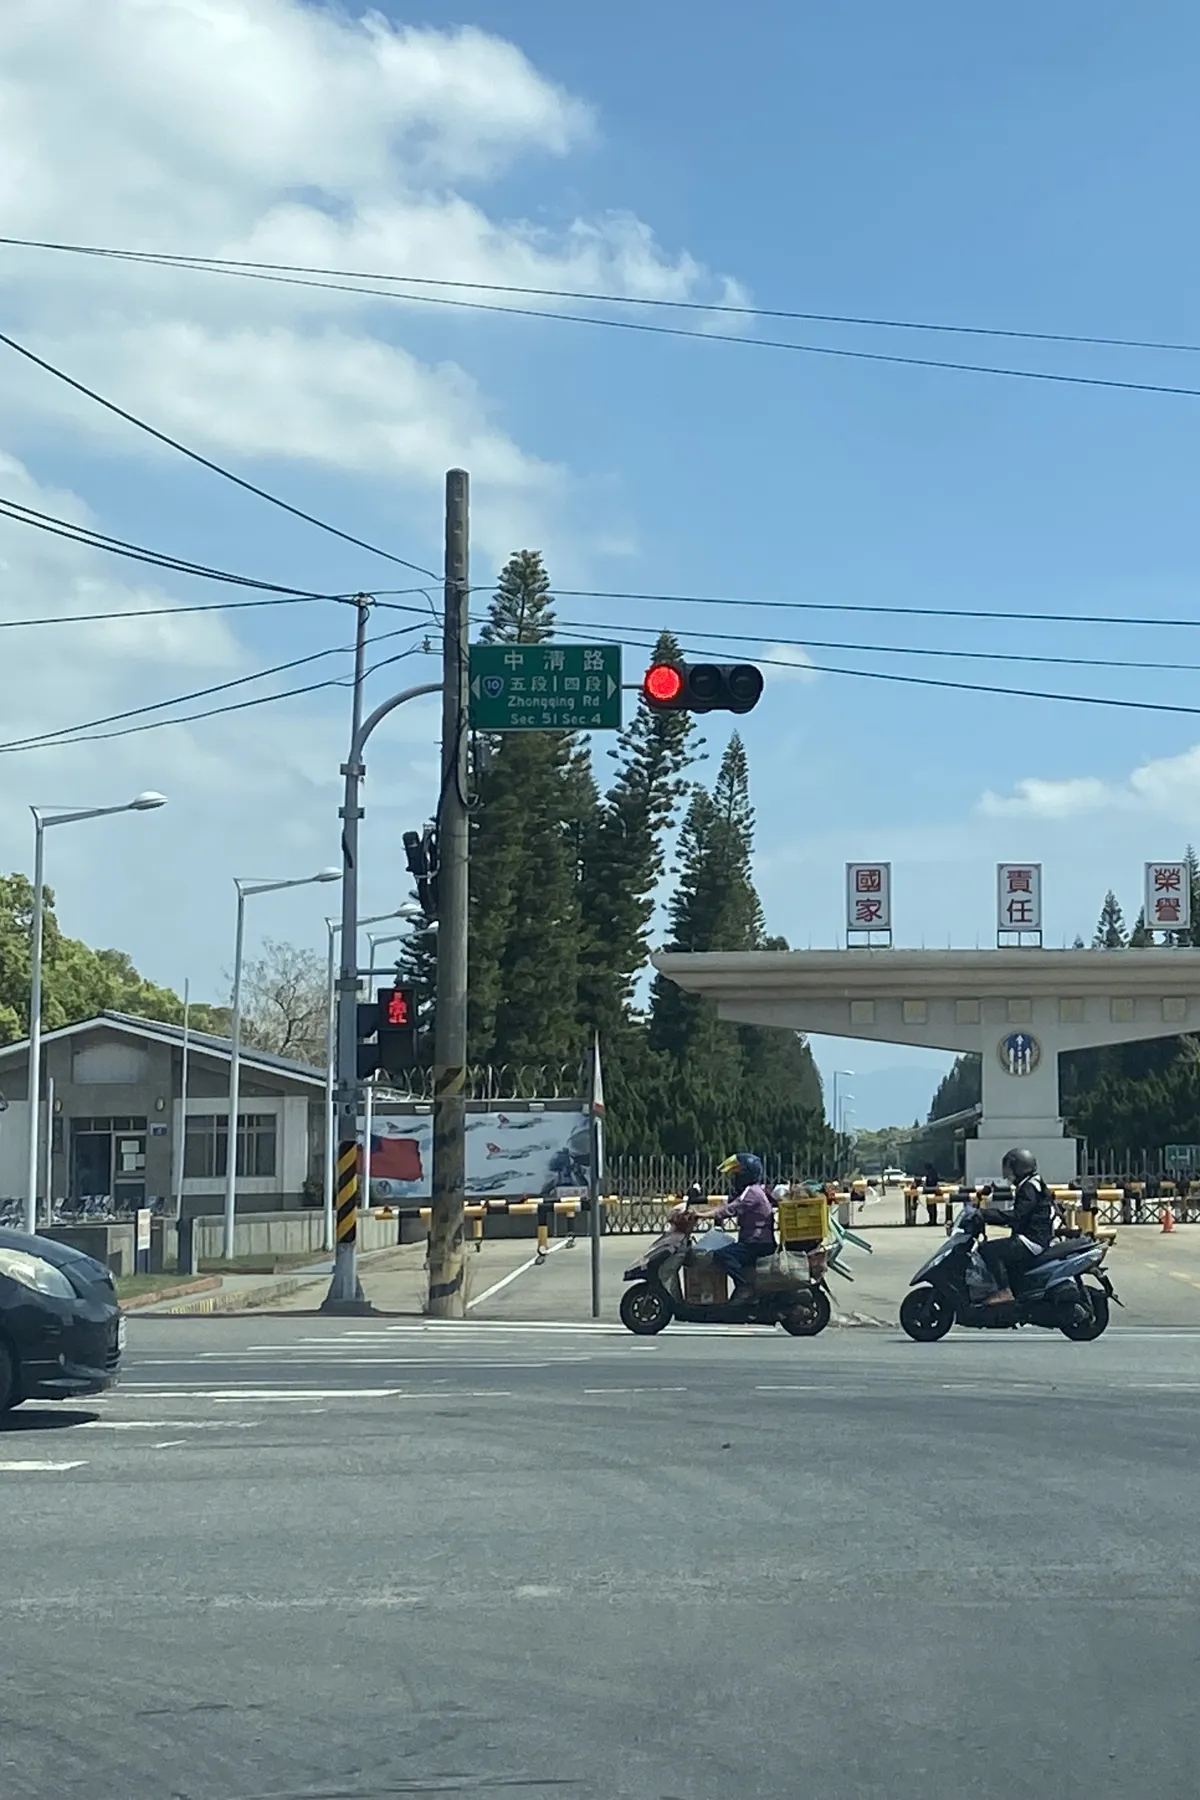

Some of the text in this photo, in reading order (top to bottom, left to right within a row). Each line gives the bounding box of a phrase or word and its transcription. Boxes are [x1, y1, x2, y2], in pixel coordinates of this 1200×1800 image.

[504, 649, 605, 671] 中清路
[486, 680, 500, 690] 10
[508, 695, 600, 710] Zhongqing Rd
[511, 713, 535, 724] Sec
[562, 713, 586, 724] Sec
[591, 713, 601, 724] 4
[855, 868, 883, 923] 國家
[1005, 868, 1034, 924] 責任
[1153, 867, 1181, 923] 榮譽
